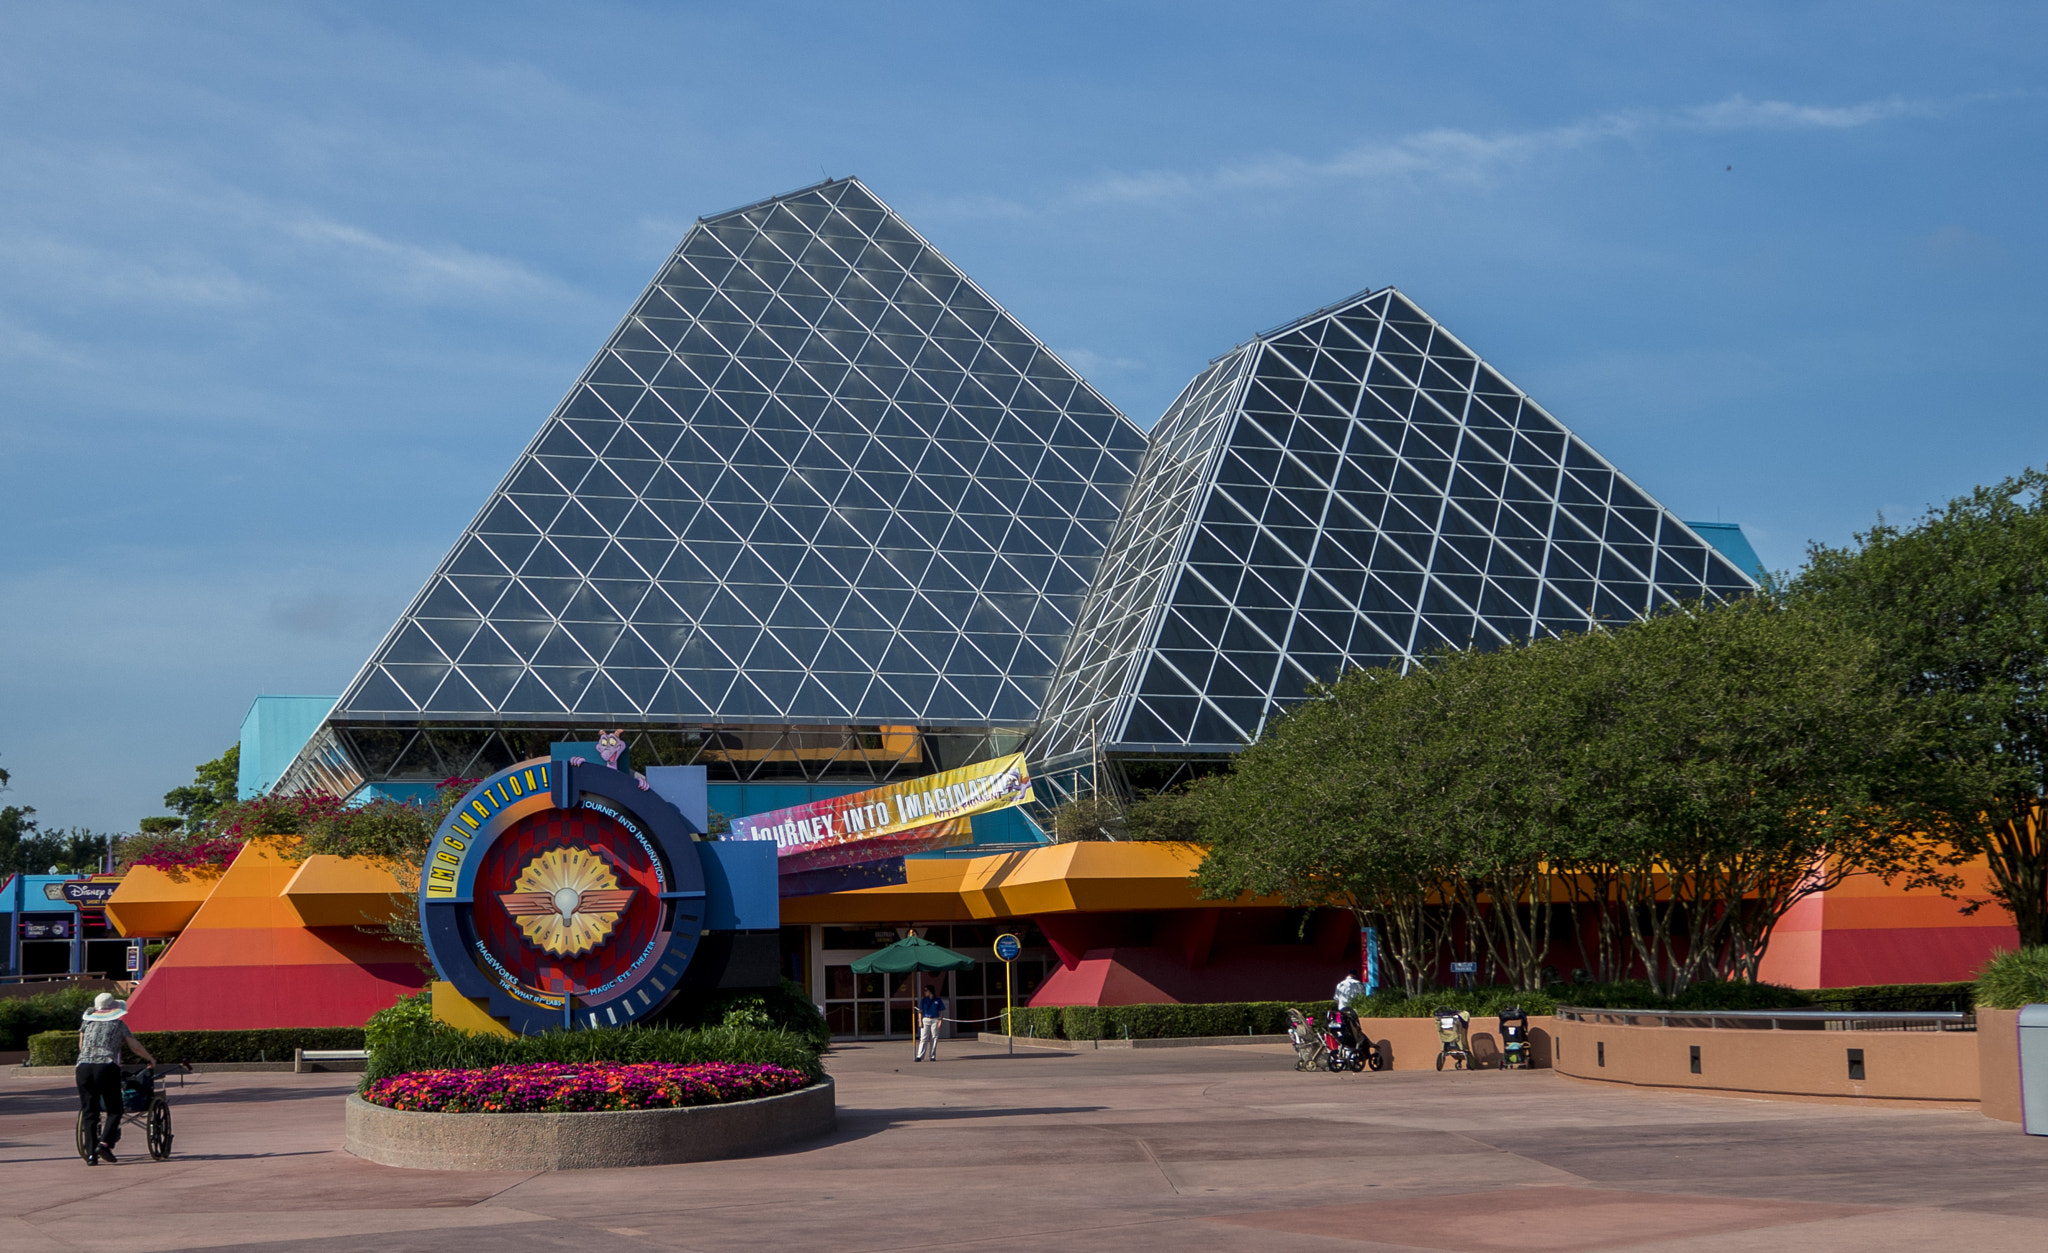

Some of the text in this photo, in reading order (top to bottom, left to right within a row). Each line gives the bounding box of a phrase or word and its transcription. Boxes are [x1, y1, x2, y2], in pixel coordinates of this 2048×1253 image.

[842, 801, 891, 834] INTO
[933, 791, 1003, 819] WITH FIGMENT
[428, 766, 550, 893] IMAGINATION!
[581, 800, 664, 883] JOURNEY INTO IMAGINATION
[475, 940, 519, 985] IMAGEWORKS
[589, 941, 656, 996] MAGIC EYE THEATER
[499, 979, 511, 991] THE
[545, 998, 562, 1007] LABS
